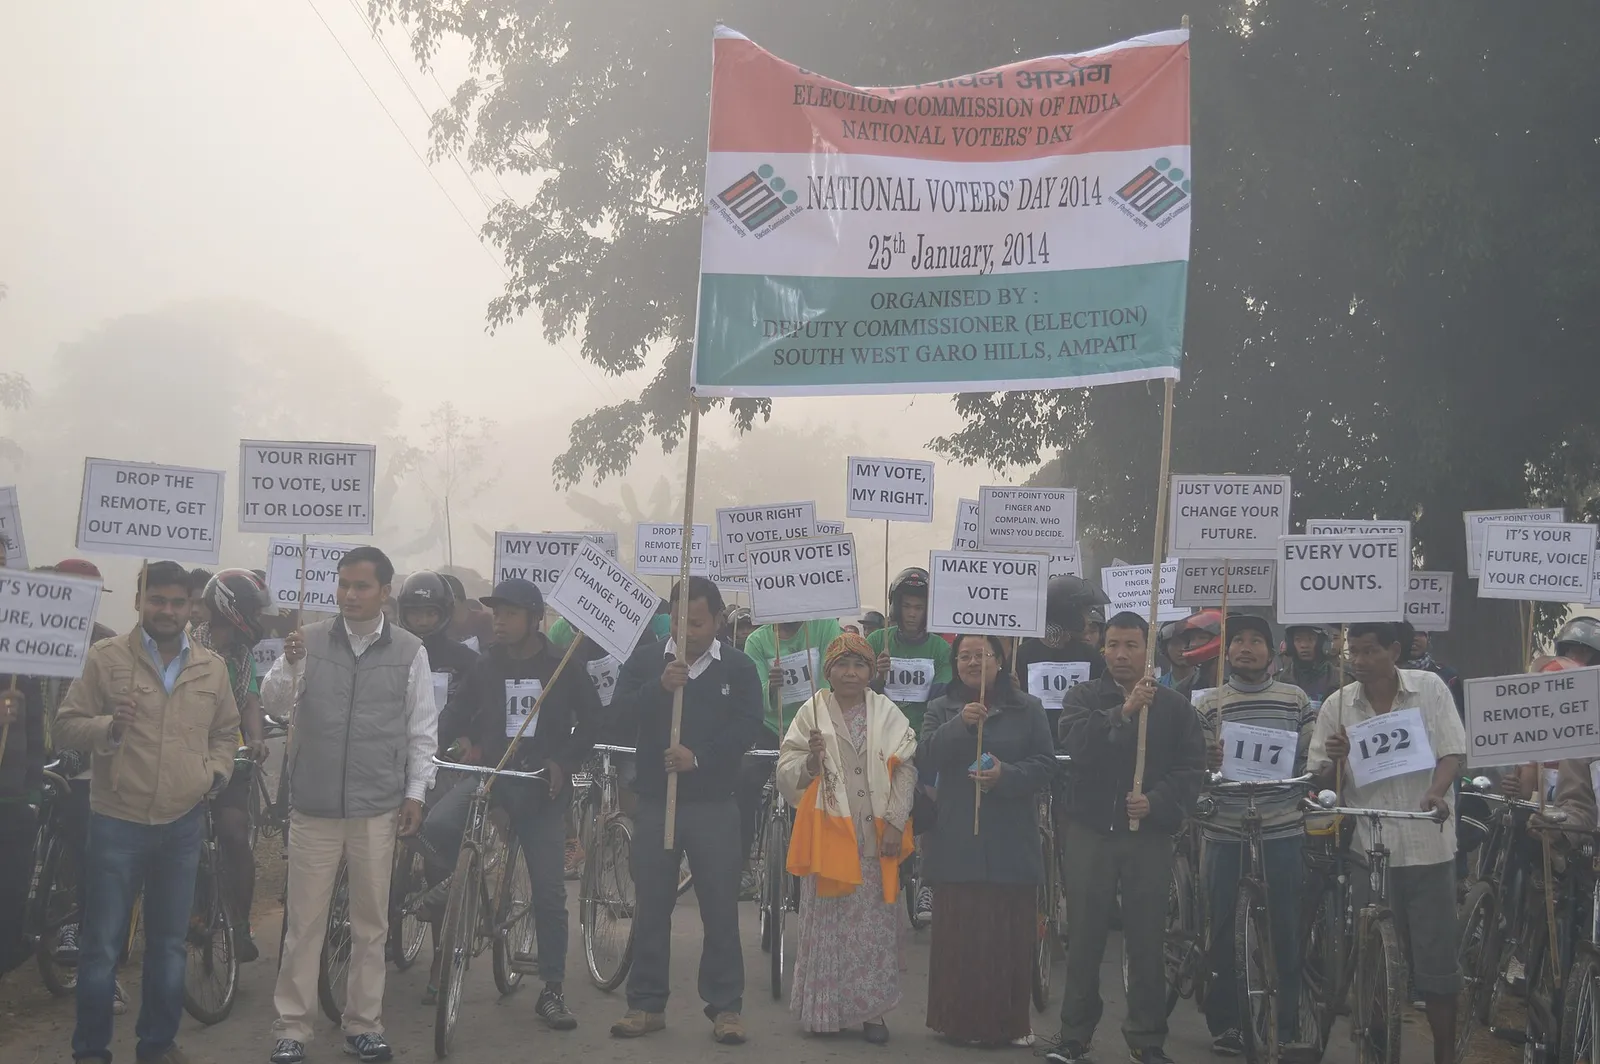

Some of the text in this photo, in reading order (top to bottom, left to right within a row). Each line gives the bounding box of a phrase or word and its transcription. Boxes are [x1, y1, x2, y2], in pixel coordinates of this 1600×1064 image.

[1016, 64, 1112, 90] आयोग
[793, 84, 1121, 117] ELECTION COMMISSION OF INDIA
[842, 120, 945, 145] NATIONAL
[1036, 125, 1074, 145] DAY
[806, 175, 920, 212] NATIONAL
[1017, 177, 1057, 210] DAY
[1057, 175, 1102, 208] 2014
[868, 232, 1050, 275] 25th January, 2014
[870, 287, 1028, 310] ORGANISED BY
[763, 305, 1148, 339] DEPUTY COMMISSIONER (ELECTION)
[773, 333, 1138, 367] SOUTH WEST GARO HILLS, AMPATI
[257, 450, 357, 467] YOUR RIGHT
[116, 471, 195, 490] DROP THE
[856, 464, 926, 483] MY VOTE,
[252, 476, 361, 493] TO VOTE, USE
[1178, 484, 1283, 496] JUST VOTE AND
[852, 489, 928, 506] MY RIGHT.
[1043, 492, 1065, 500] YOUR
[100, 495, 206, 516] REMOTE, GET
[245, 502, 366, 518] IT OR LOOSE IT.
[1004, 504, 1032, 512] FINGER
[1180, 506, 1279, 518] CHANGE YOUR
[728, 508, 802, 523] YOUR RIGHT
[995, 516, 1060, 525] COMPLAIN. WHO
[88, 519, 213, 543] OUT AND VOTE.
[652, 527, 694, 536] DROP TE
[963, 521, 977, 532] TO
[990, 528, 1065, 538] WINS? YOU DECIDE.
[1201, 528, 1257, 540] FUTURE.
[727, 528, 808, 543] TO VOTE, USE
[957, 538, 966, 547] IT
[1533, 530, 1571, 542] YOUR
[505, 540, 532, 554] MY
[644, 541, 702, 551] REMOTE, ET
[751, 543, 850, 565] YOUR VOTE IS
[1285, 543, 1397, 560] EVERY VOTE
[639, 555, 657, 563] OUT
[659, 555, 678, 563] AND
[689, 556, 706, 564] OTE.
[724, 553, 734, 564] IT
[1488, 550, 1588, 565] FUTURE, VOICE
[501, 568, 527, 581] MY
[942, 559, 988, 574] MAKE
[993, 561, 1037, 576] YOUR
[1185, 565, 1270, 577] GET YOURSELF
[581, 547, 653, 610] JUST VOTE AND
[755, 575, 796, 590] YOUR
[1125, 579, 1149, 587] FINGER
[1300, 575, 1382, 591] COUNTS.
[1409, 578, 1443, 592] OTE,
[1488, 572, 1525, 584] YOUR
[1529, 574, 1582, 587] CHOICE.
[27, 582, 72, 600] YOUR
[574, 567, 642, 626] CHANGE YOUR
[968, 586, 1009, 600] VOTE
[1193, 584, 1257, 595] ENROLLED.
[576, 595, 616, 633] FUTURE.
[1404, 602, 1444, 614] IGHT.
[40, 613, 87, 631] VOICE
[952, 612, 1021, 628] COUNTS.
[16, 639, 77, 658] CHOICE.
[889, 670, 926, 685] 108
[1041, 674, 1080, 691] 105
[1495, 677, 1574, 697] DROP THE
[506, 696, 538, 715] 19
[1483, 700, 1589, 722] REMOTE, GET
[1475, 723, 1599, 746] OUT AND VOTE.
[1358, 728, 1411, 760] 122
[1233, 740, 1283, 765] 117
